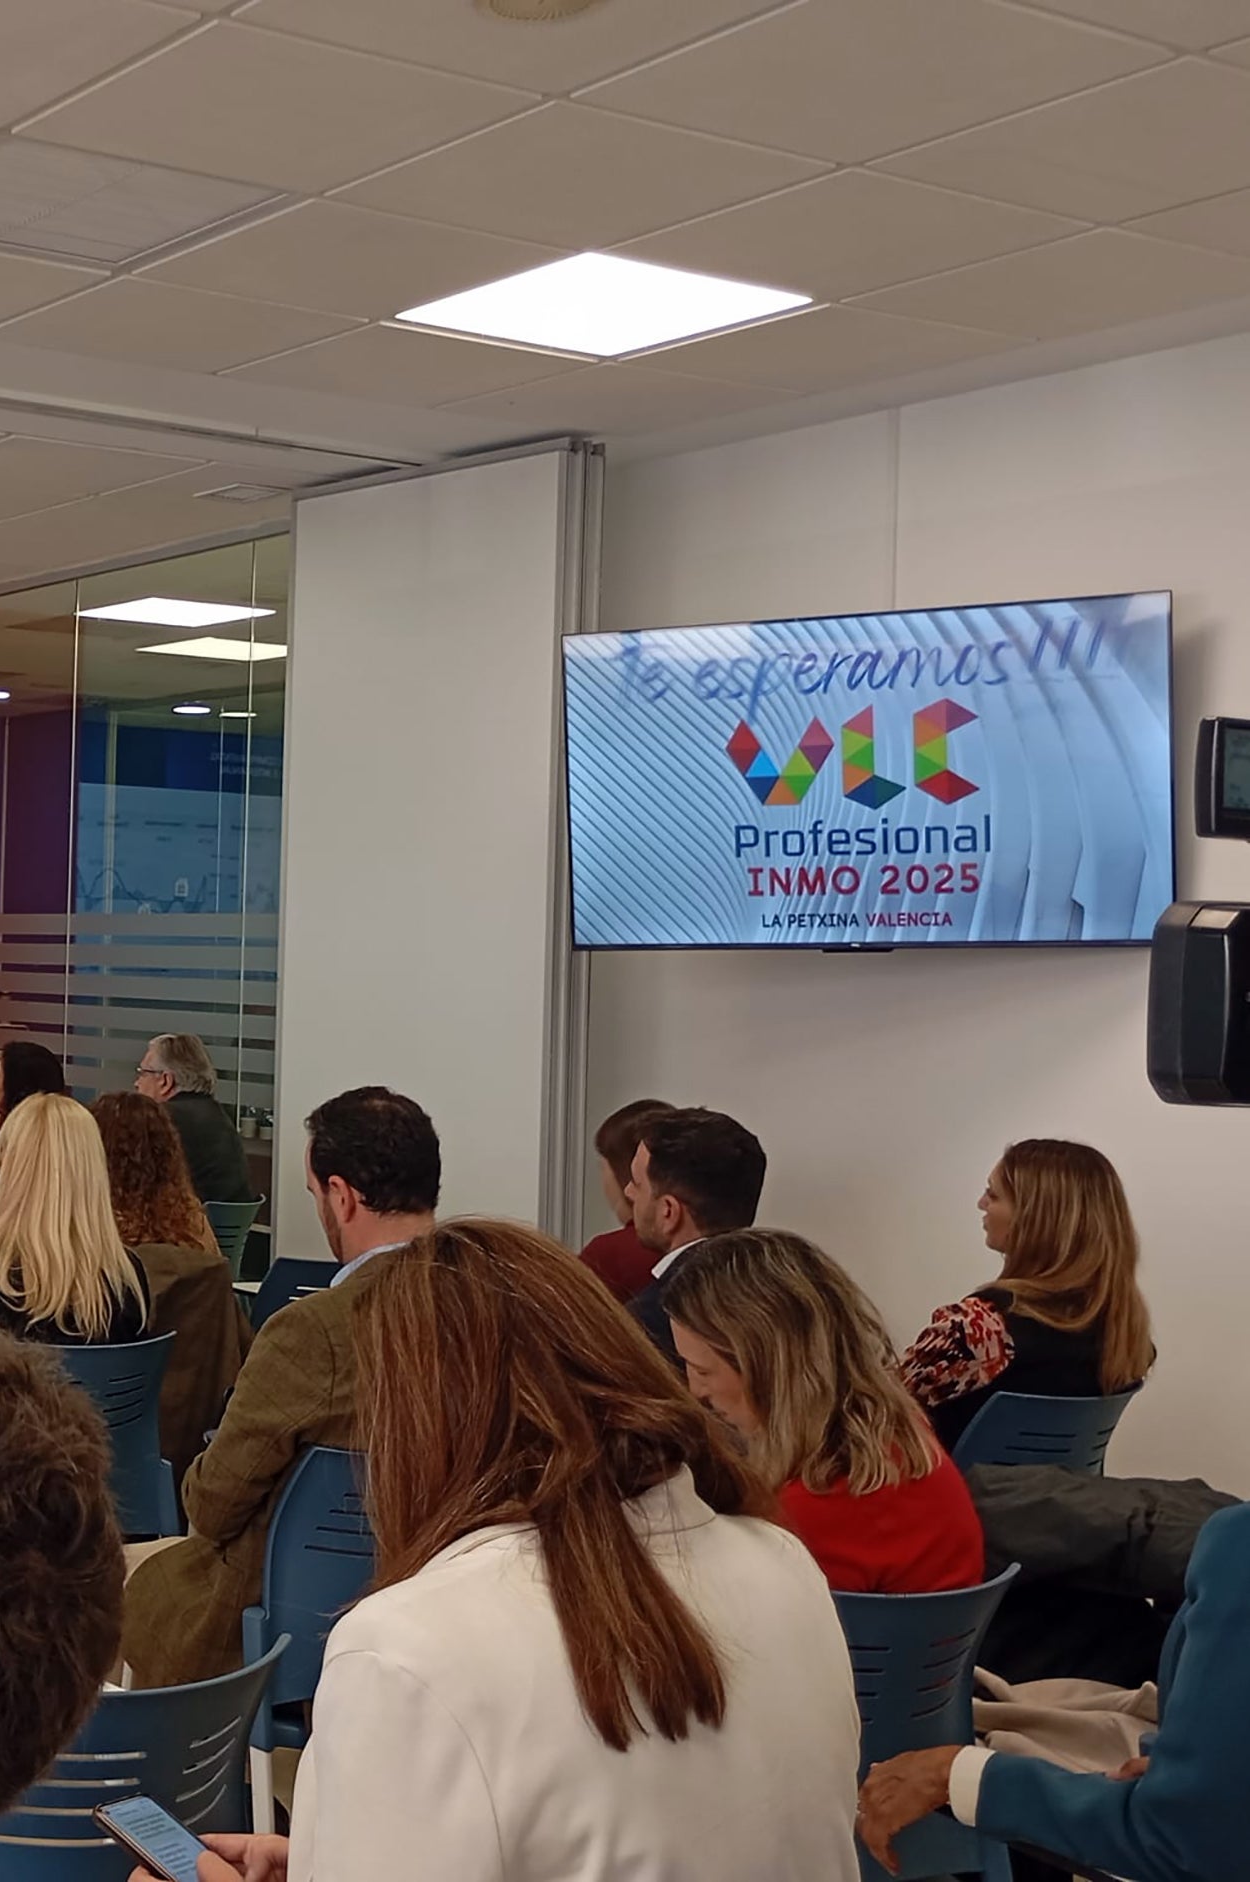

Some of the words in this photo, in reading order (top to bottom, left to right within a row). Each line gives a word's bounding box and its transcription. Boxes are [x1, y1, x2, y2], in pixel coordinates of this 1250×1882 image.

[734, 814, 991, 858] Profesional
[748, 865, 861, 897] INMO
[879, 863, 980, 895] 2025
[761, 914, 782, 928] LA
[787, 913, 860, 928] PETXINA
[865, 911, 953, 927] VALENCIA
